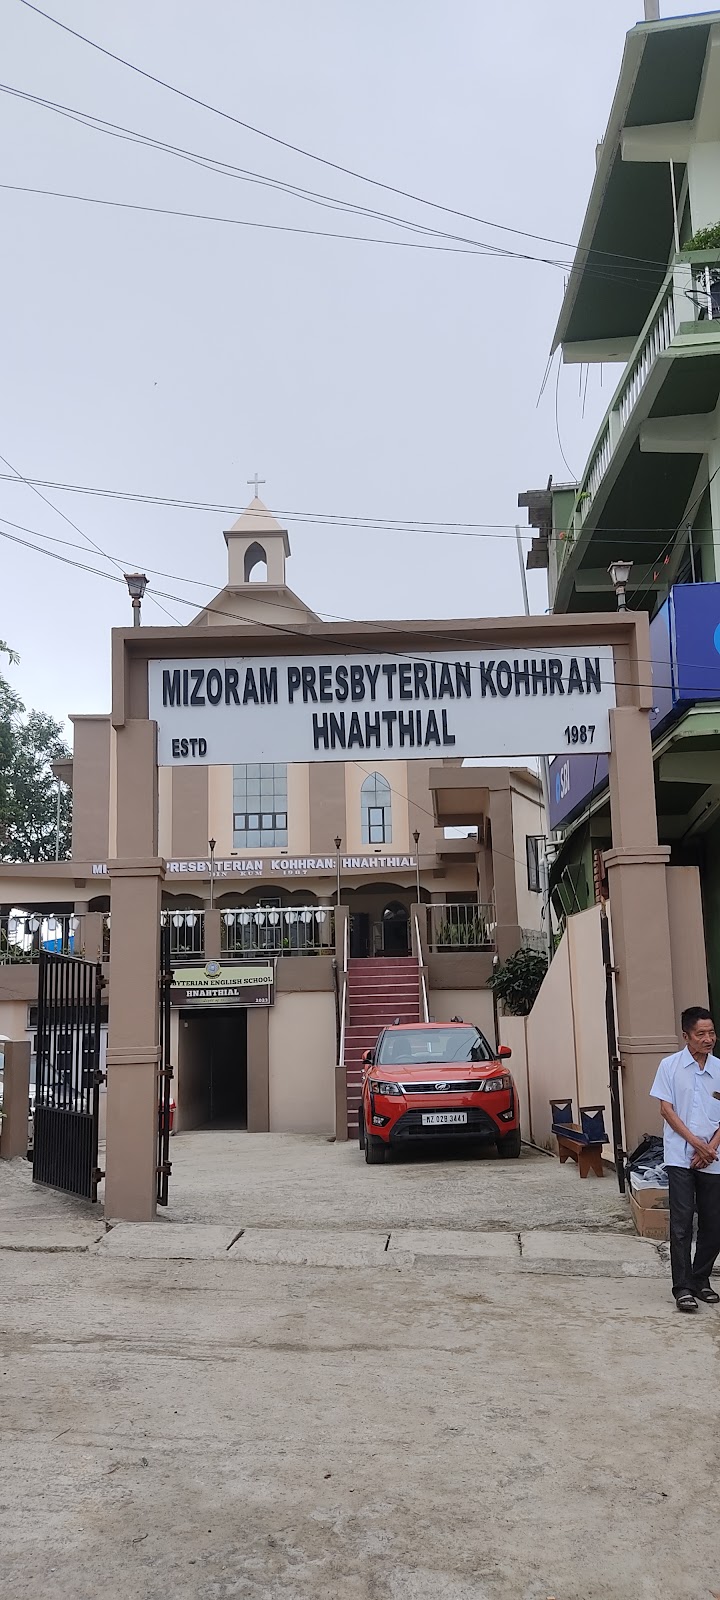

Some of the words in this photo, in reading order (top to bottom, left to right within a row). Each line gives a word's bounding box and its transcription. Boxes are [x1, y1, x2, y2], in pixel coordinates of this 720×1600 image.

[161, 667, 278, 707] MIZORAM
[288, 661, 472, 703] PRESBYTERIAN
[480, 657, 602, 697] KOHHRAN
[312, 708, 456, 750] HNAHTHIAL
[564, 724, 597, 745] 1987
[171, 737, 208, 758] ESTD
[560, 759, 570, 799] SBI
[271, 858, 337, 870] KOHHRAN:
[342, 856, 418, 868] HNAHTHIAL
[186, 989, 239, 997] HNAHTHIAL
[449, 1114, 465, 1122] 3441
